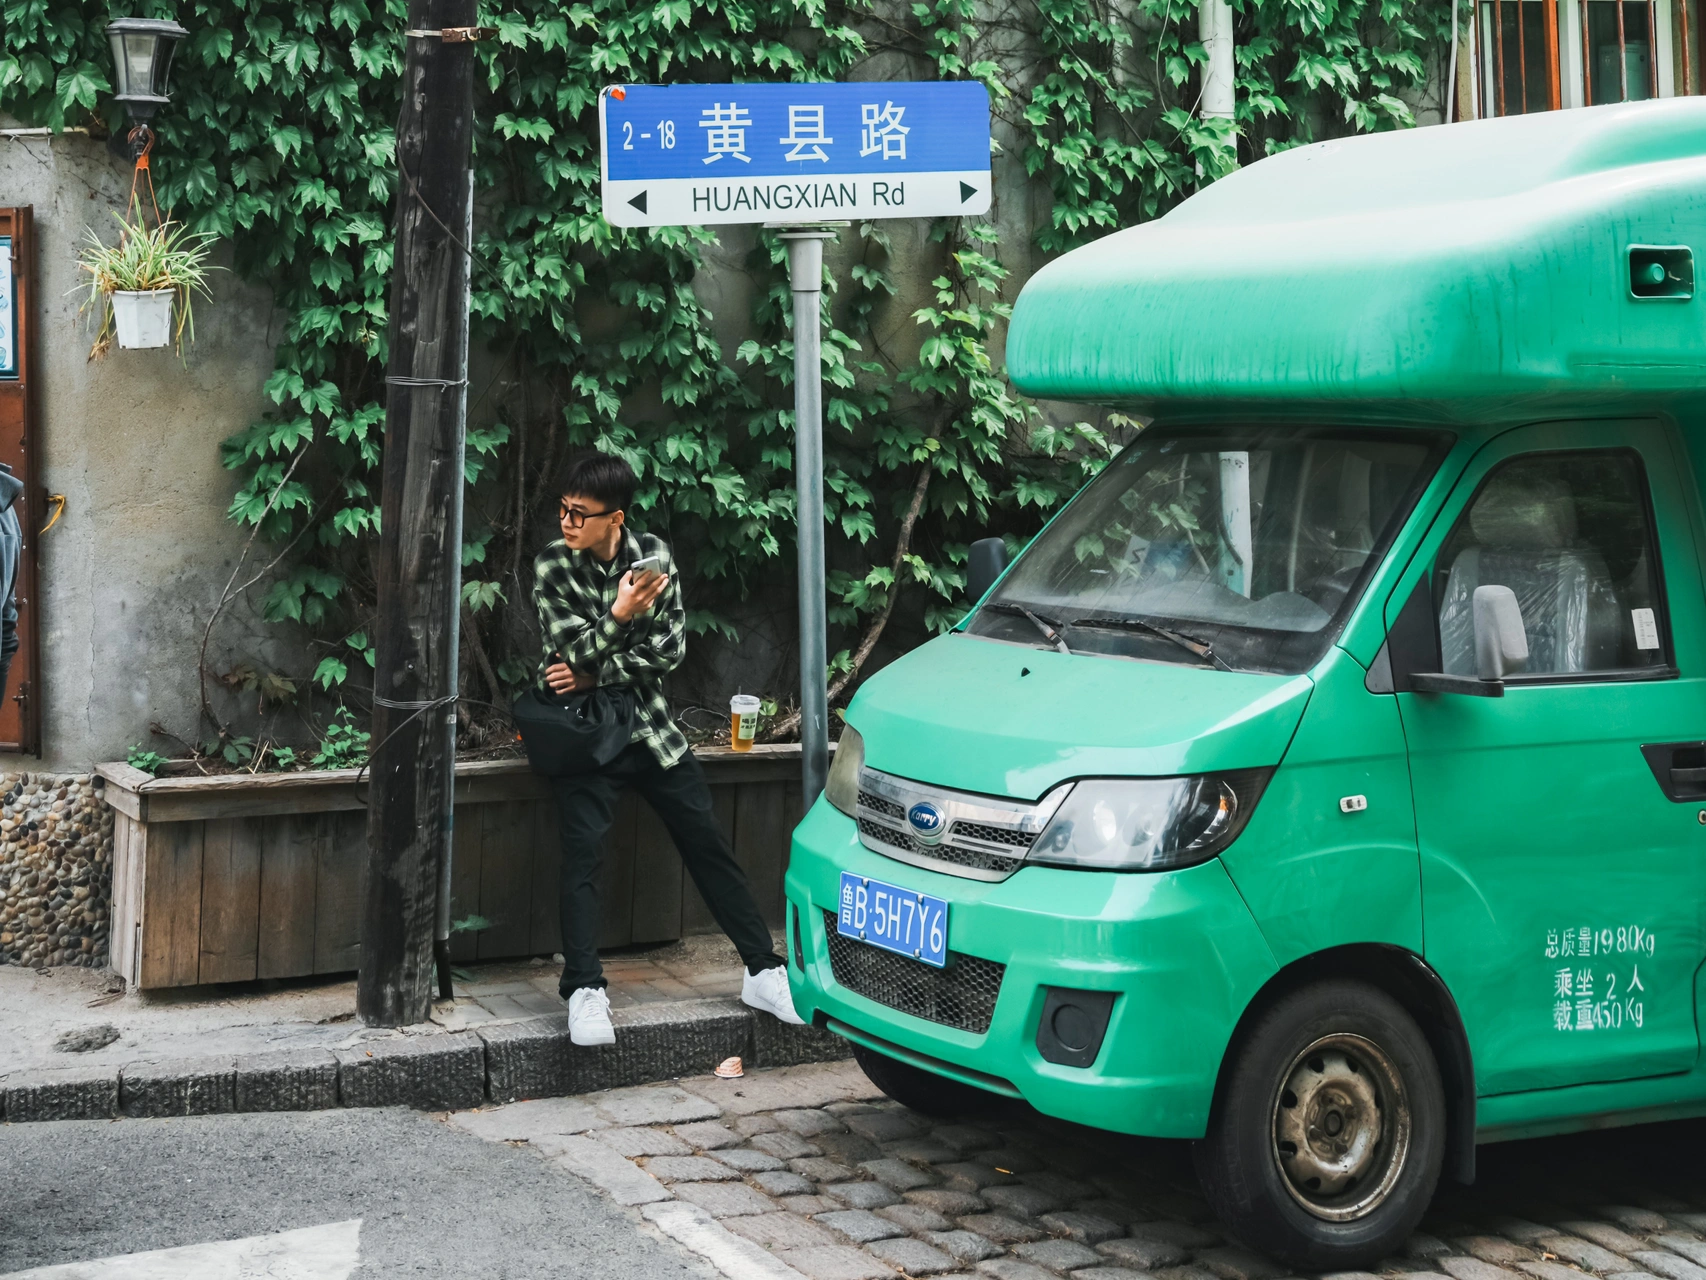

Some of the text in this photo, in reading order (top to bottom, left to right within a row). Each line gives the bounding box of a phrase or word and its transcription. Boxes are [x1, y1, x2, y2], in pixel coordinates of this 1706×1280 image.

[698, 100, 911, 165] 黄县路
[692, 181, 905, 212] HUANGXIAN Rd
[911, 809, 937, 826] Karry
